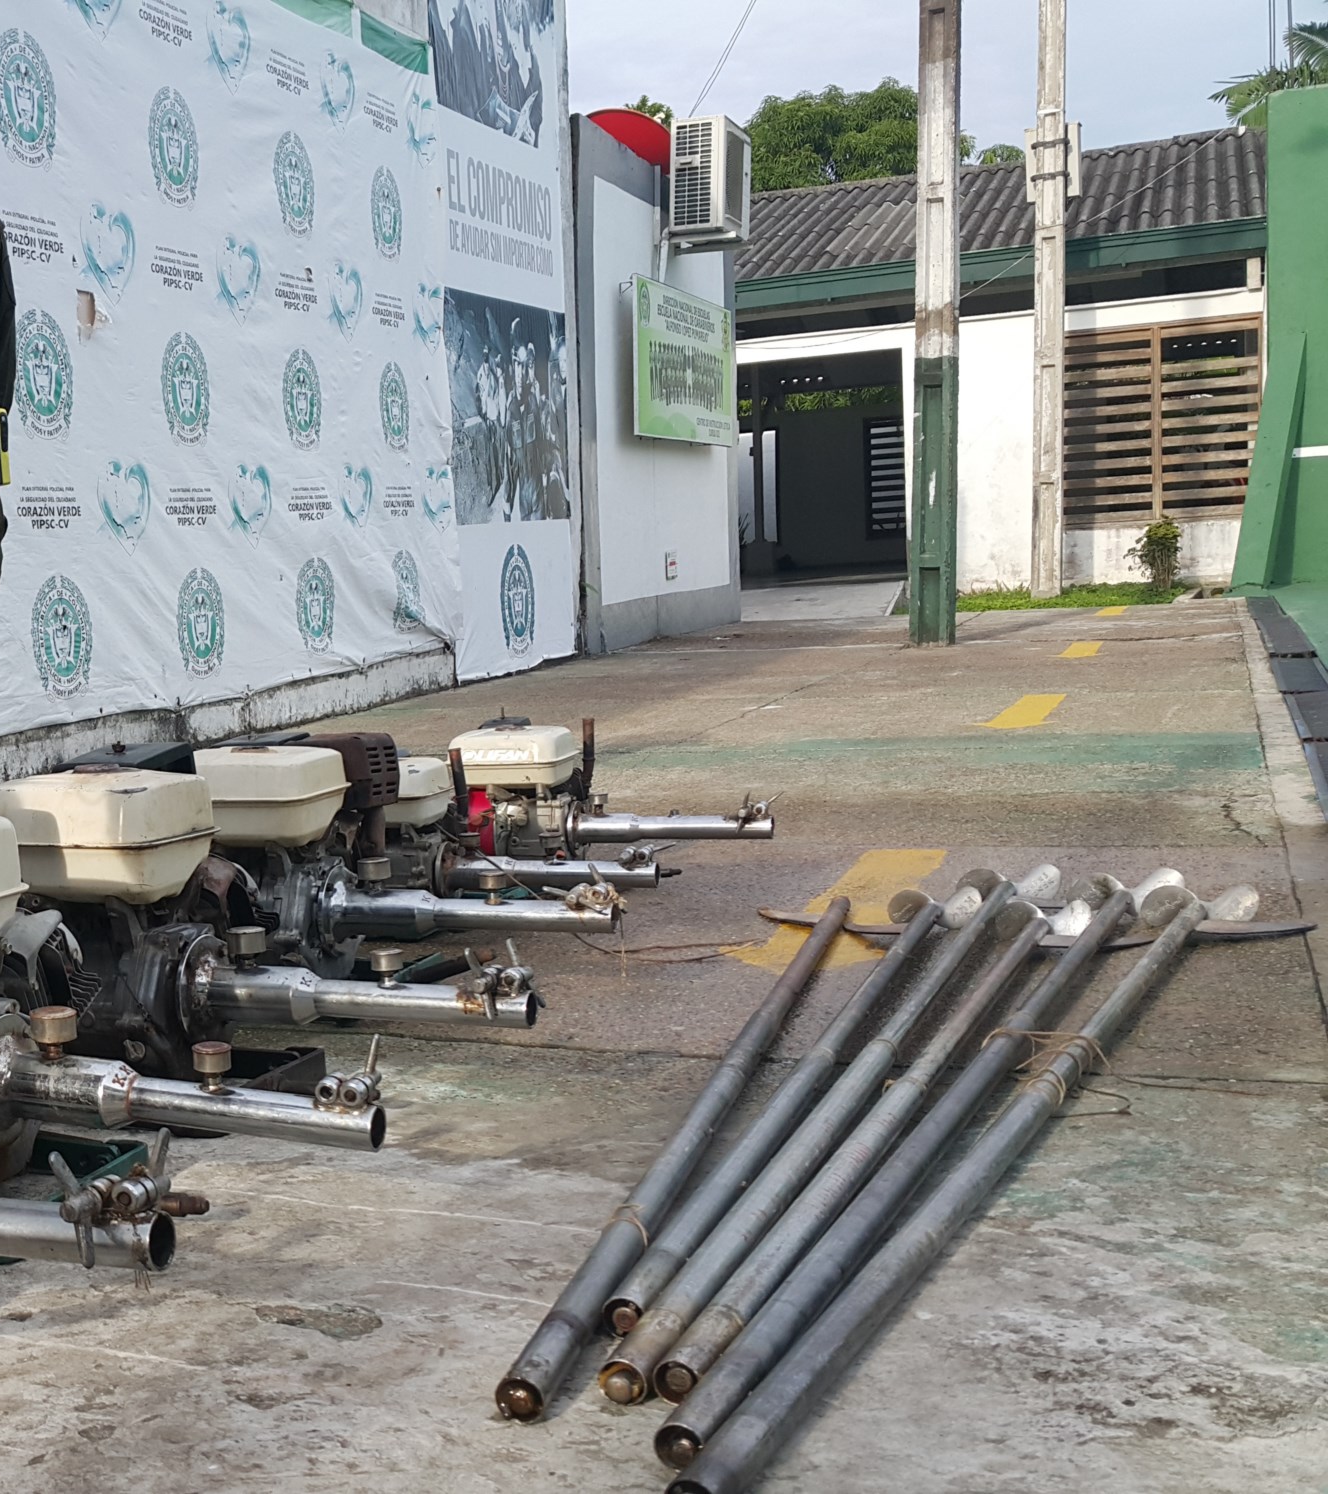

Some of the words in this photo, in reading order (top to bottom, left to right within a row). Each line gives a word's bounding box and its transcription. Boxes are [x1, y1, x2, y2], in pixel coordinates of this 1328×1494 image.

[138, 8, 171, 31] CORAZÓN
[172, 23, 193, 41] VERDE
[151, 26, 183, 47] PIPSC-CV
[446, 147, 466, 214] EL
[467, 157, 552, 242] COMPROMISO
[3, 230, 36, 248] ORAZÓN
[38, 237, 64, 254] VERDE
[449, 218, 460, 252] DE
[461, 222, 490, 261] AYUDAR
[490, 231, 503, 264] SIN
[503, 235, 536, 273] IMPORTAR
[536, 241, 553, 278] CÓMO
[12, 246, 51, 264] PIPSC-CV
[151, 263, 182, 278] CORAZÓN
[183, 269, 203, 282] VERDE
[163, 277, 193, 291] PIPSC-CV
[17, 503, 55, 517] CORAZÓN
[56, 505, 82, 517] VERDE
[165, 503, 195, 515] CORAZÓN
[196, 504, 217, 515] VERDE
[31, 519, 70, 529] PIPSC-CV
[177, 516, 207, 527] PIPSC-CV
[479, 749, 530, 761] LIFAN
